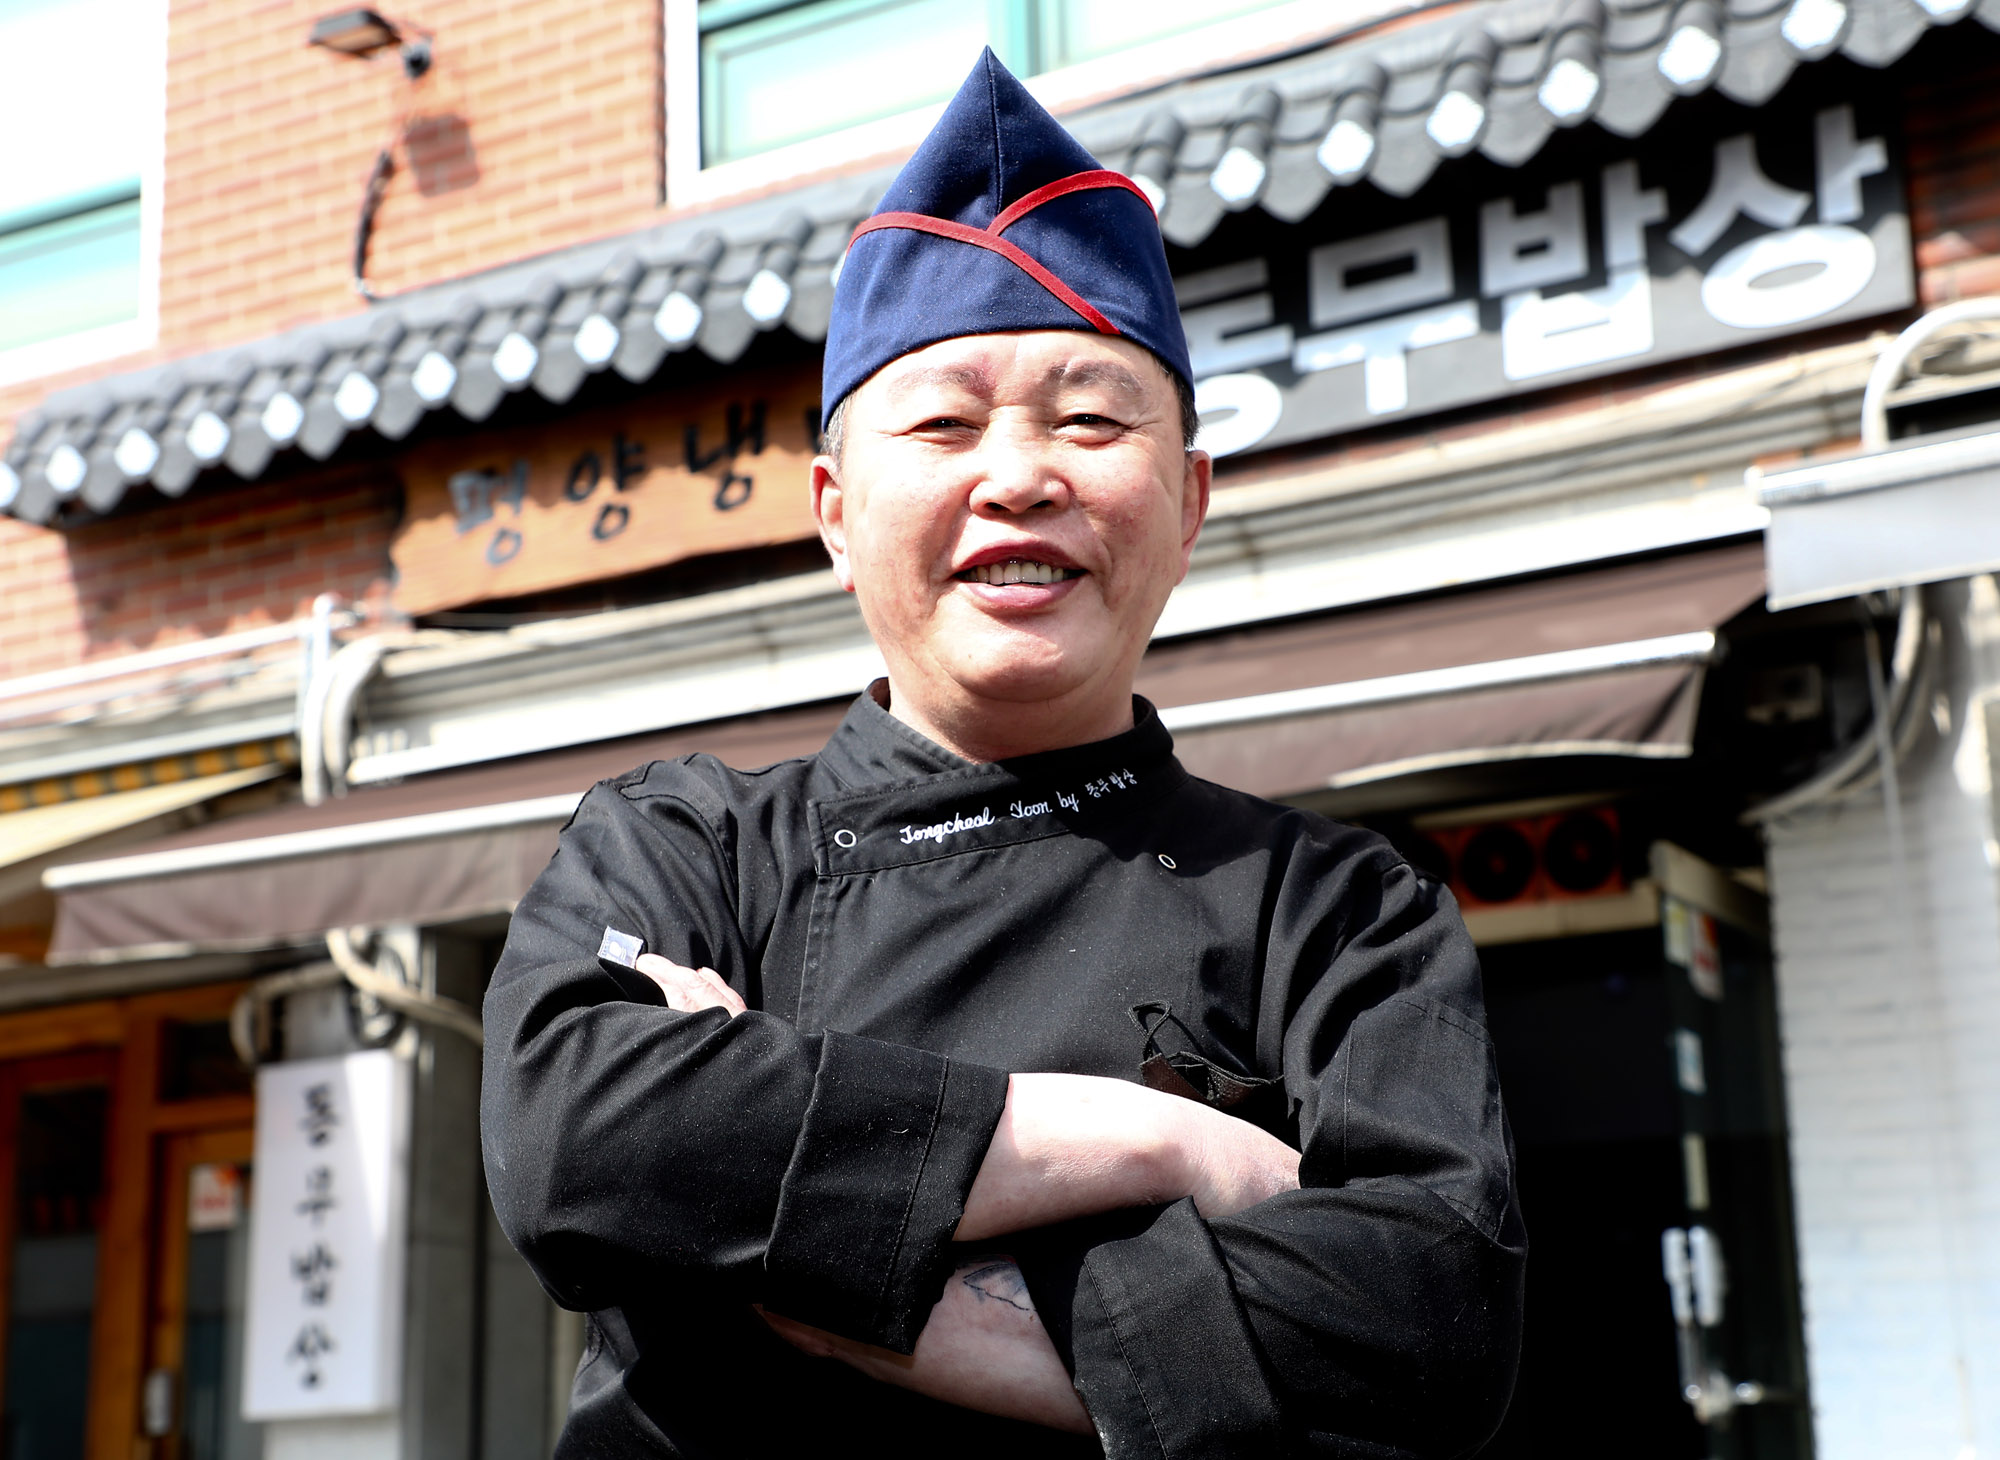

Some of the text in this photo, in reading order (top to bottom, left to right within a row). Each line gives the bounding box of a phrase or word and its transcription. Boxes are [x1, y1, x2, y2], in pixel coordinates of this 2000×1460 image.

[1178, 106, 1887, 458] 동무밥상
[449, 401, 824, 566] 평양냉
[1056, 791, 1079, 812] by
